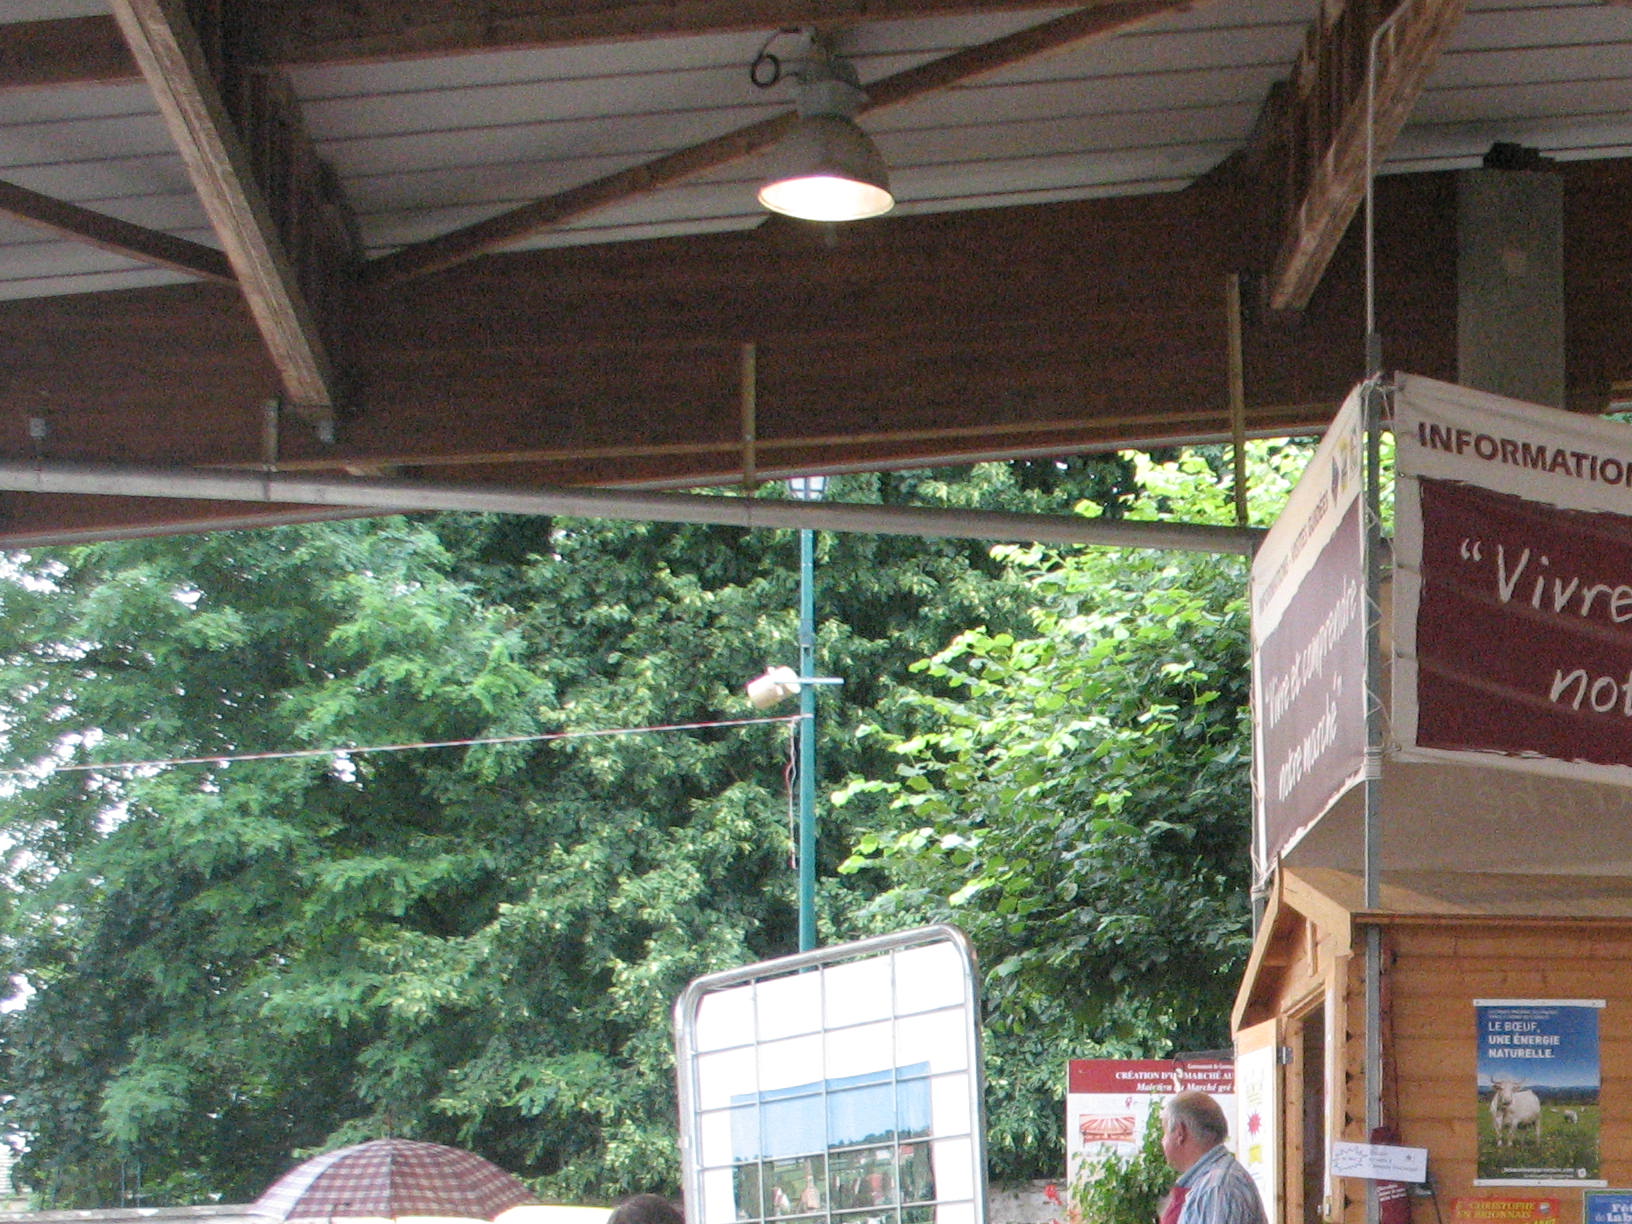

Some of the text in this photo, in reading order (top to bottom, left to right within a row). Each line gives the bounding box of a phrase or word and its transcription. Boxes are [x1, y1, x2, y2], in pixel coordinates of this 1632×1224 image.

[1488, 1021, 1503, 1032] LE
[1488, 1034, 1512, 1045] UNE
[1115, 1070, 1160, 1080] CRÉATION
